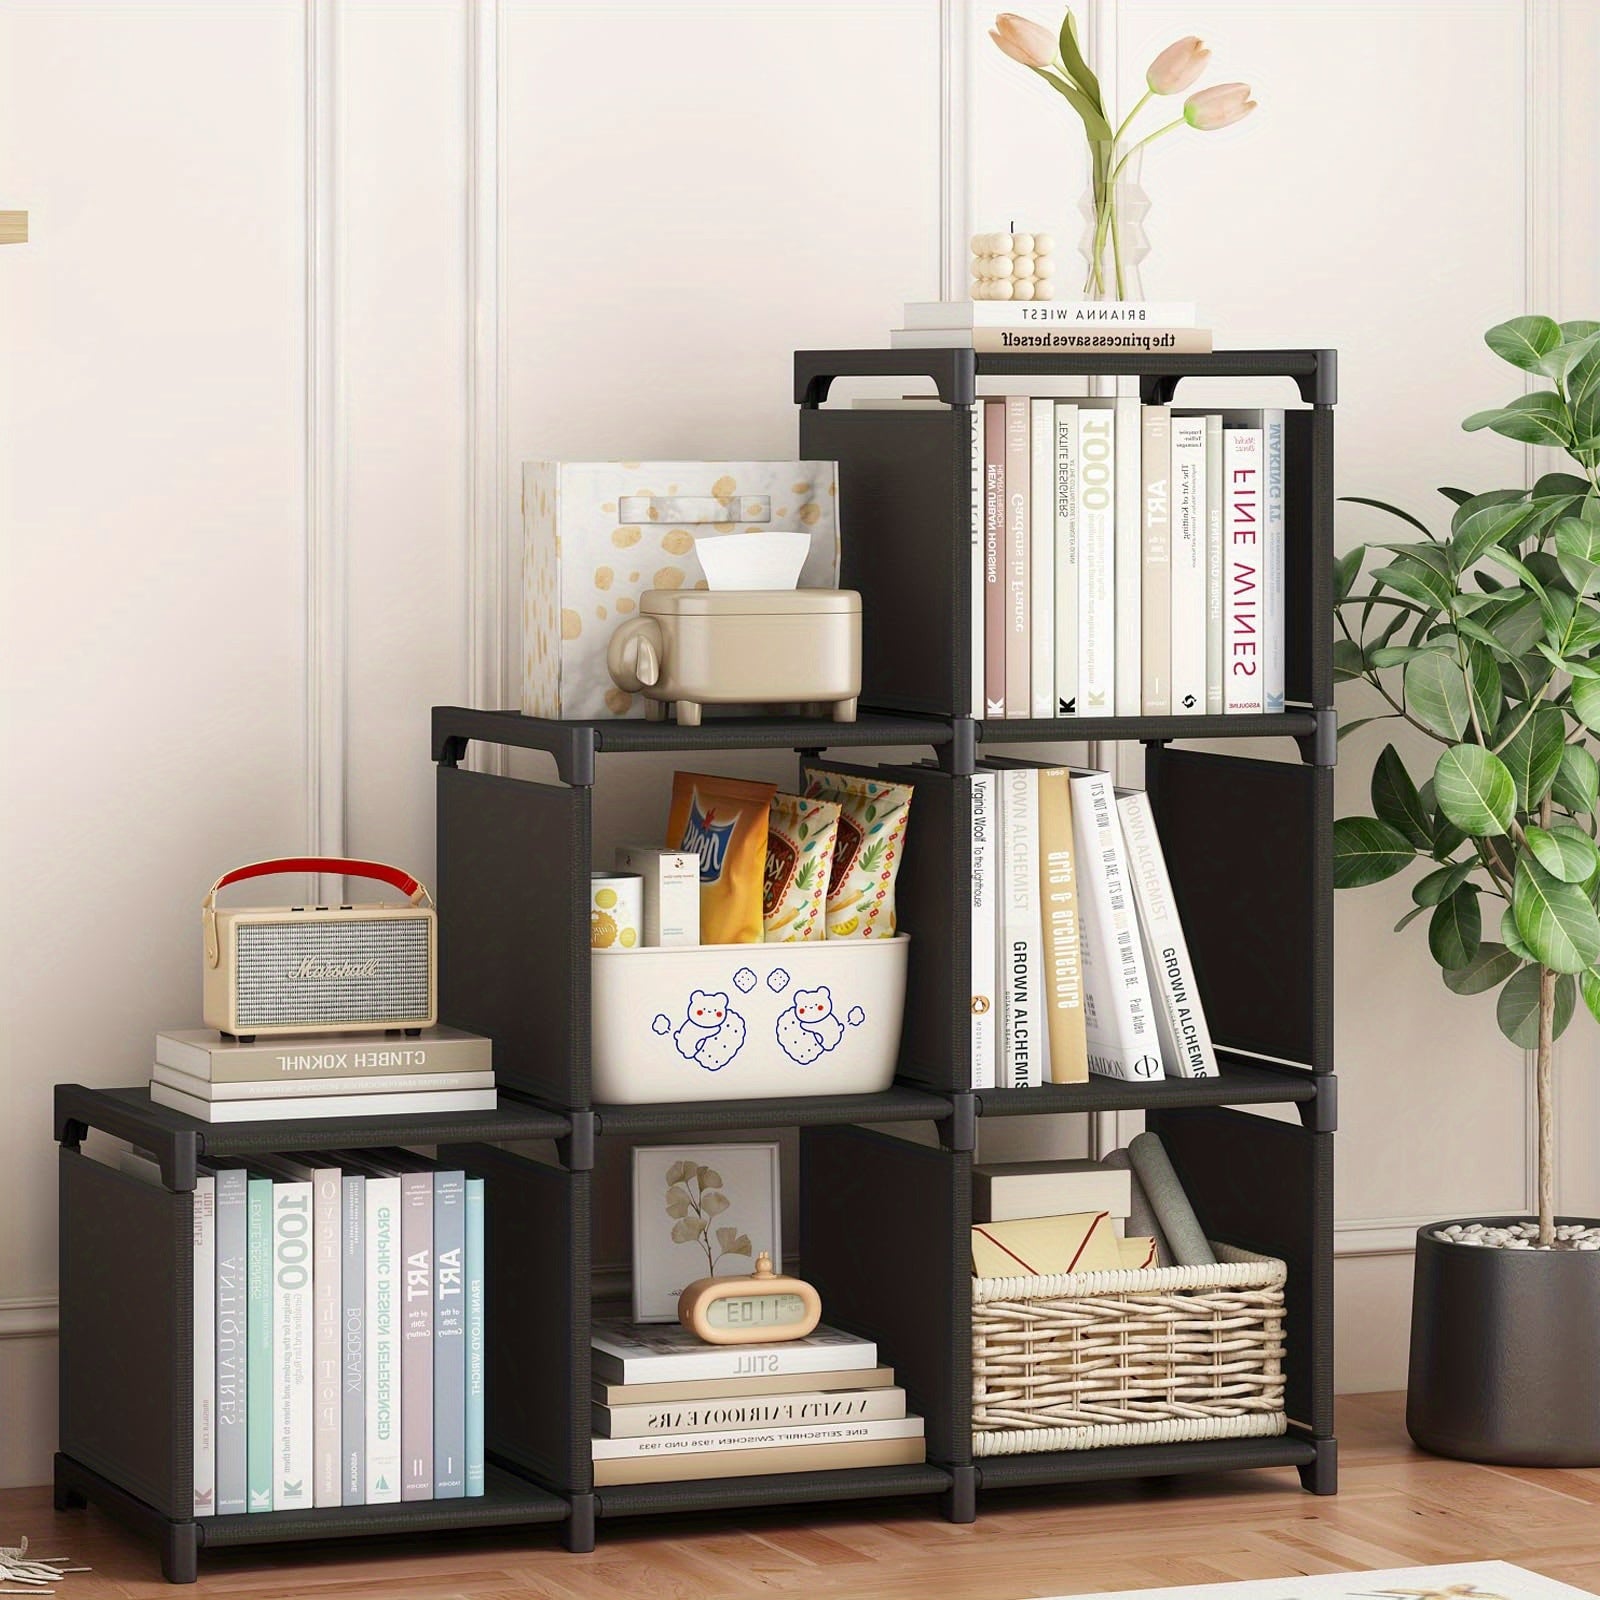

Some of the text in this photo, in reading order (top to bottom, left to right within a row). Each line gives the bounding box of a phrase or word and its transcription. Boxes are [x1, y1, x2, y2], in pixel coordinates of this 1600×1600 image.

[971, 781, 988, 908] Virginia Woolf To the Lighthouse
[1012, 824, 1029, 911] ALCHEMIST
[1047, 850, 1074, 885] arts
[1133, 845, 1168, 922] ALCHEMIST
[288, 955, 380, 979] Marshall
[1013, 941, 1028, 1003] GROWN
[1051, 910, 1081, 1010] architecture
[1119, 945, 1135, 965] WANT
[1162, 947, 1188, 1003] GROWN
[1128, 998, 1143, 1014] Paul
[1131, 1015, 1146, 1035] Arden
